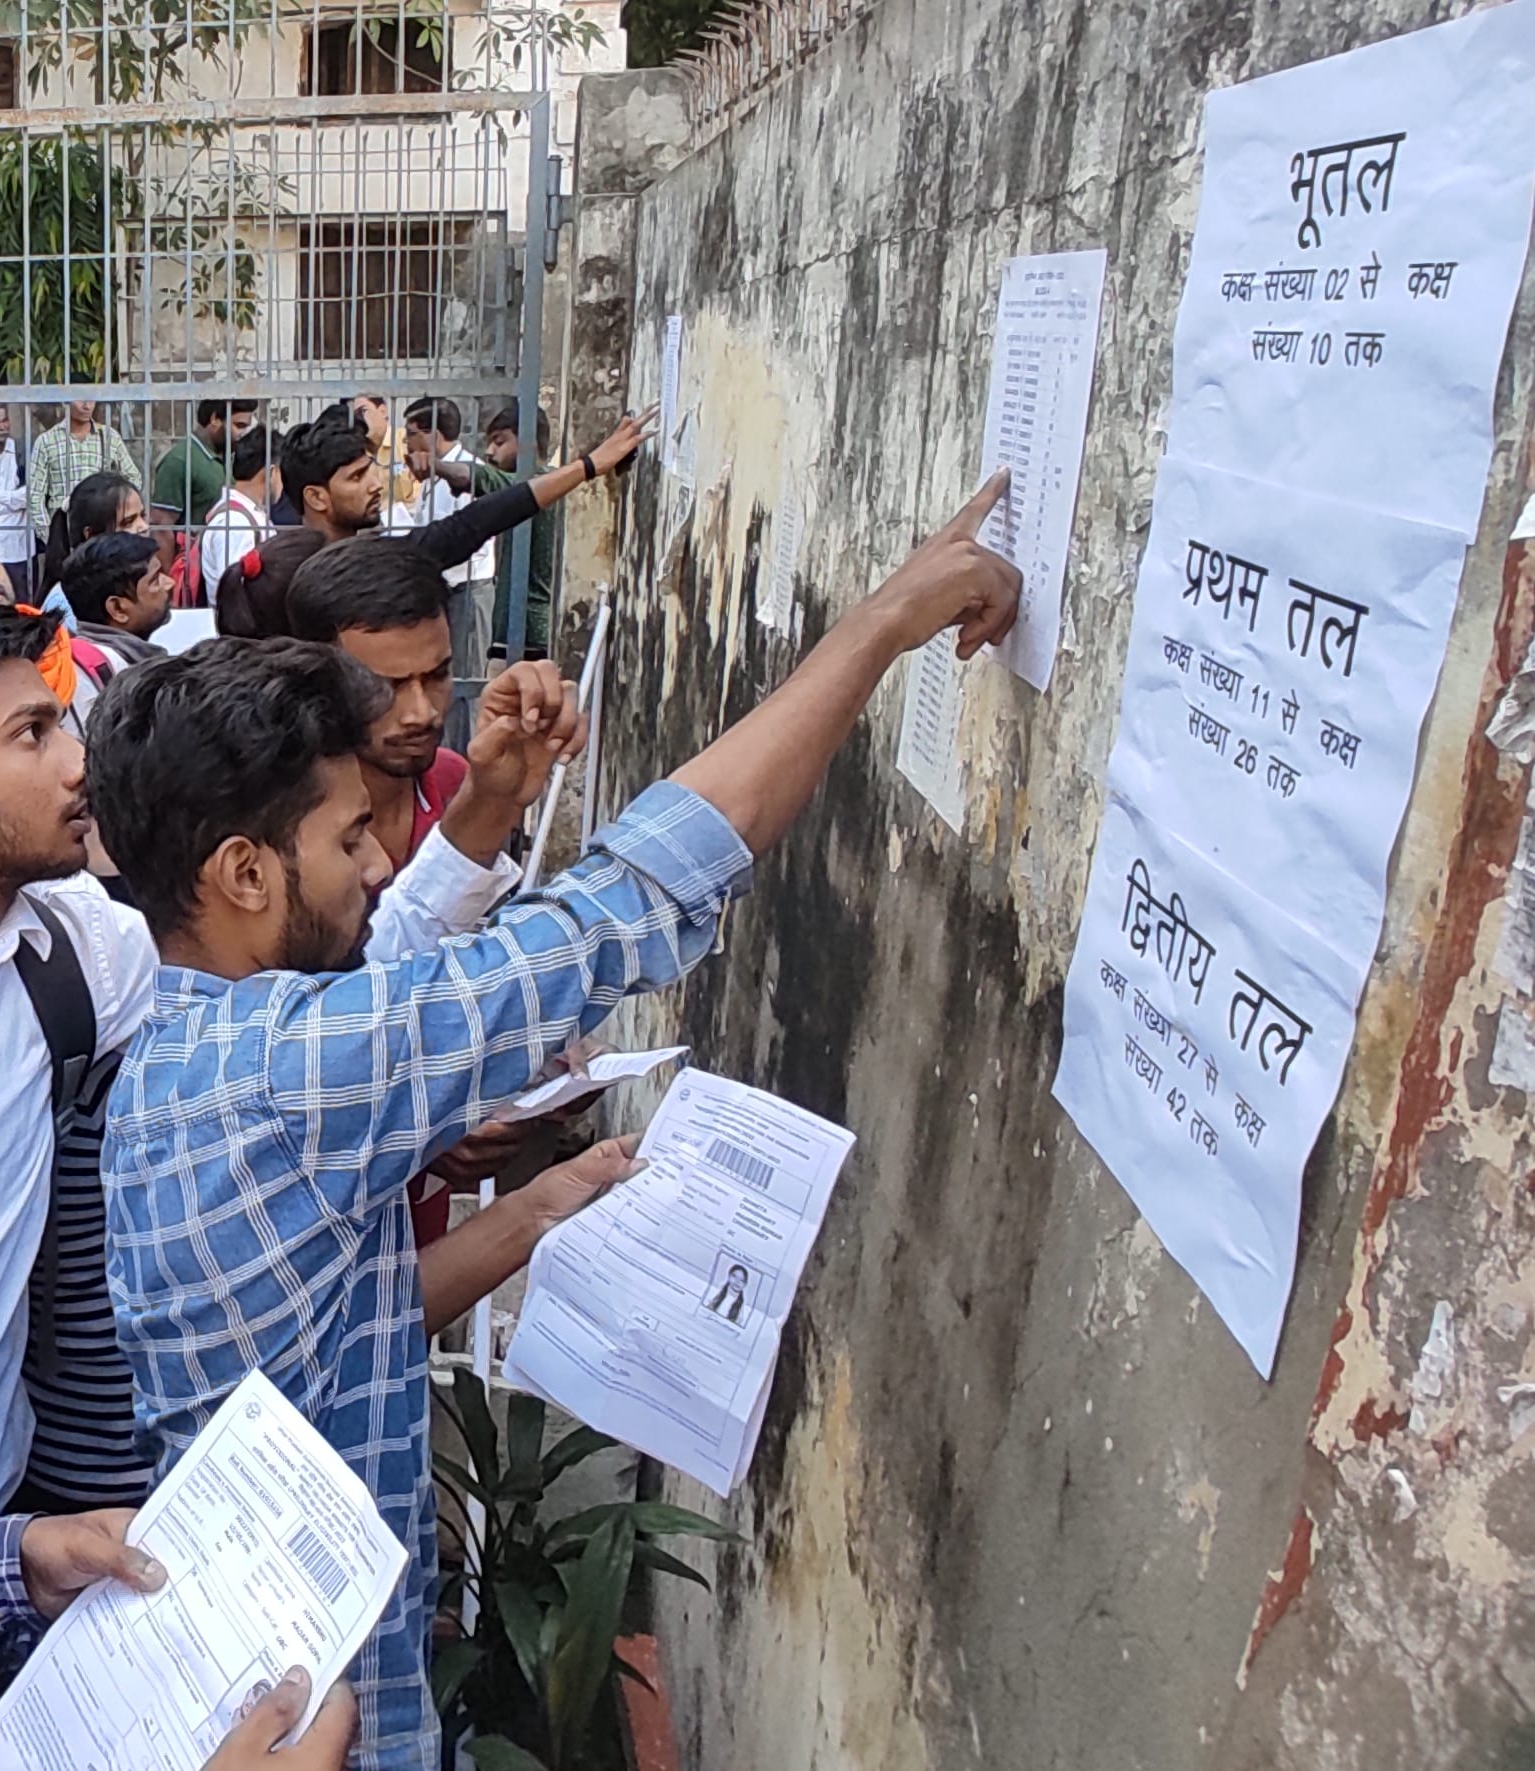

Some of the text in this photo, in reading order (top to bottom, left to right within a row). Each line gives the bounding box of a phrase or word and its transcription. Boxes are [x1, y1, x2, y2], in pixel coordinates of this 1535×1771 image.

[1289, 131, 1407, 249] भूतल
[1220, 251, 1459, 304] कक्ष संख्या 02 से कक्ष
[1250, 320, 1386, 368] संख्या 10 तक
[1182, 539, 1370, 678] प्रथम तल
[1163, 635, 1362, 770] कक्ष संख्या 11 से कक्ष
[1188, 702, 1302, 799] संख्या 26 तक
[1121, 858, 1314, 1087] द्वितीय तल
[1100, 958, 1267, 1149] कक्ष संख्या 27 से कक्ष
[1124, 1032, 1218, 1156] संख्या 42 तक
